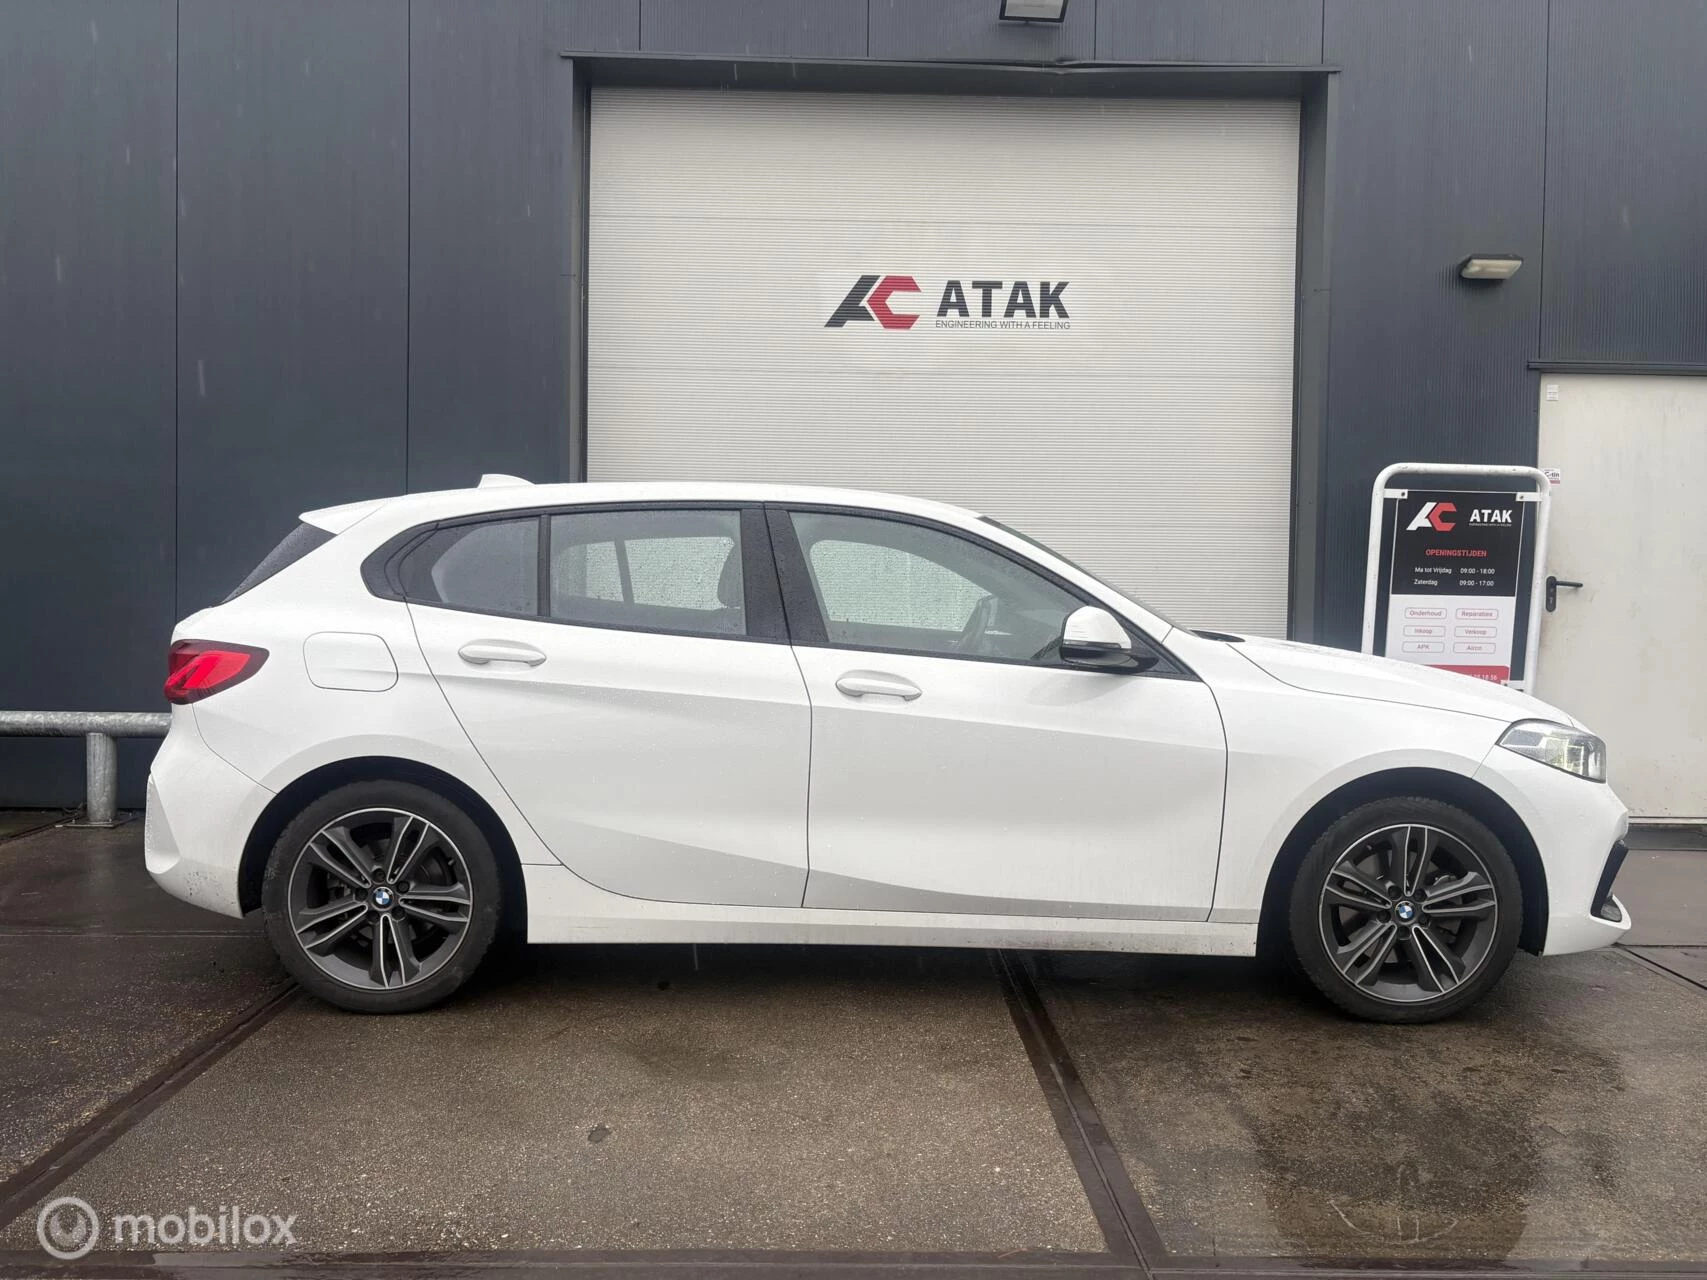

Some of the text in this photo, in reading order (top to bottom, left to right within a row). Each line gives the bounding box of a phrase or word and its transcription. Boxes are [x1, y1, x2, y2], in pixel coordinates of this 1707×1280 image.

[936, 280, 1070, 319] ATAK
[935, 319, 1071, 330] ENGINEERING WITH A FEELING
[1469, 509, 1512, 523] ATAK
[1425, 549, 1487, 557] OPENINGSTIJDEN
[1433, 567, 1452, 575] Vrijdag
